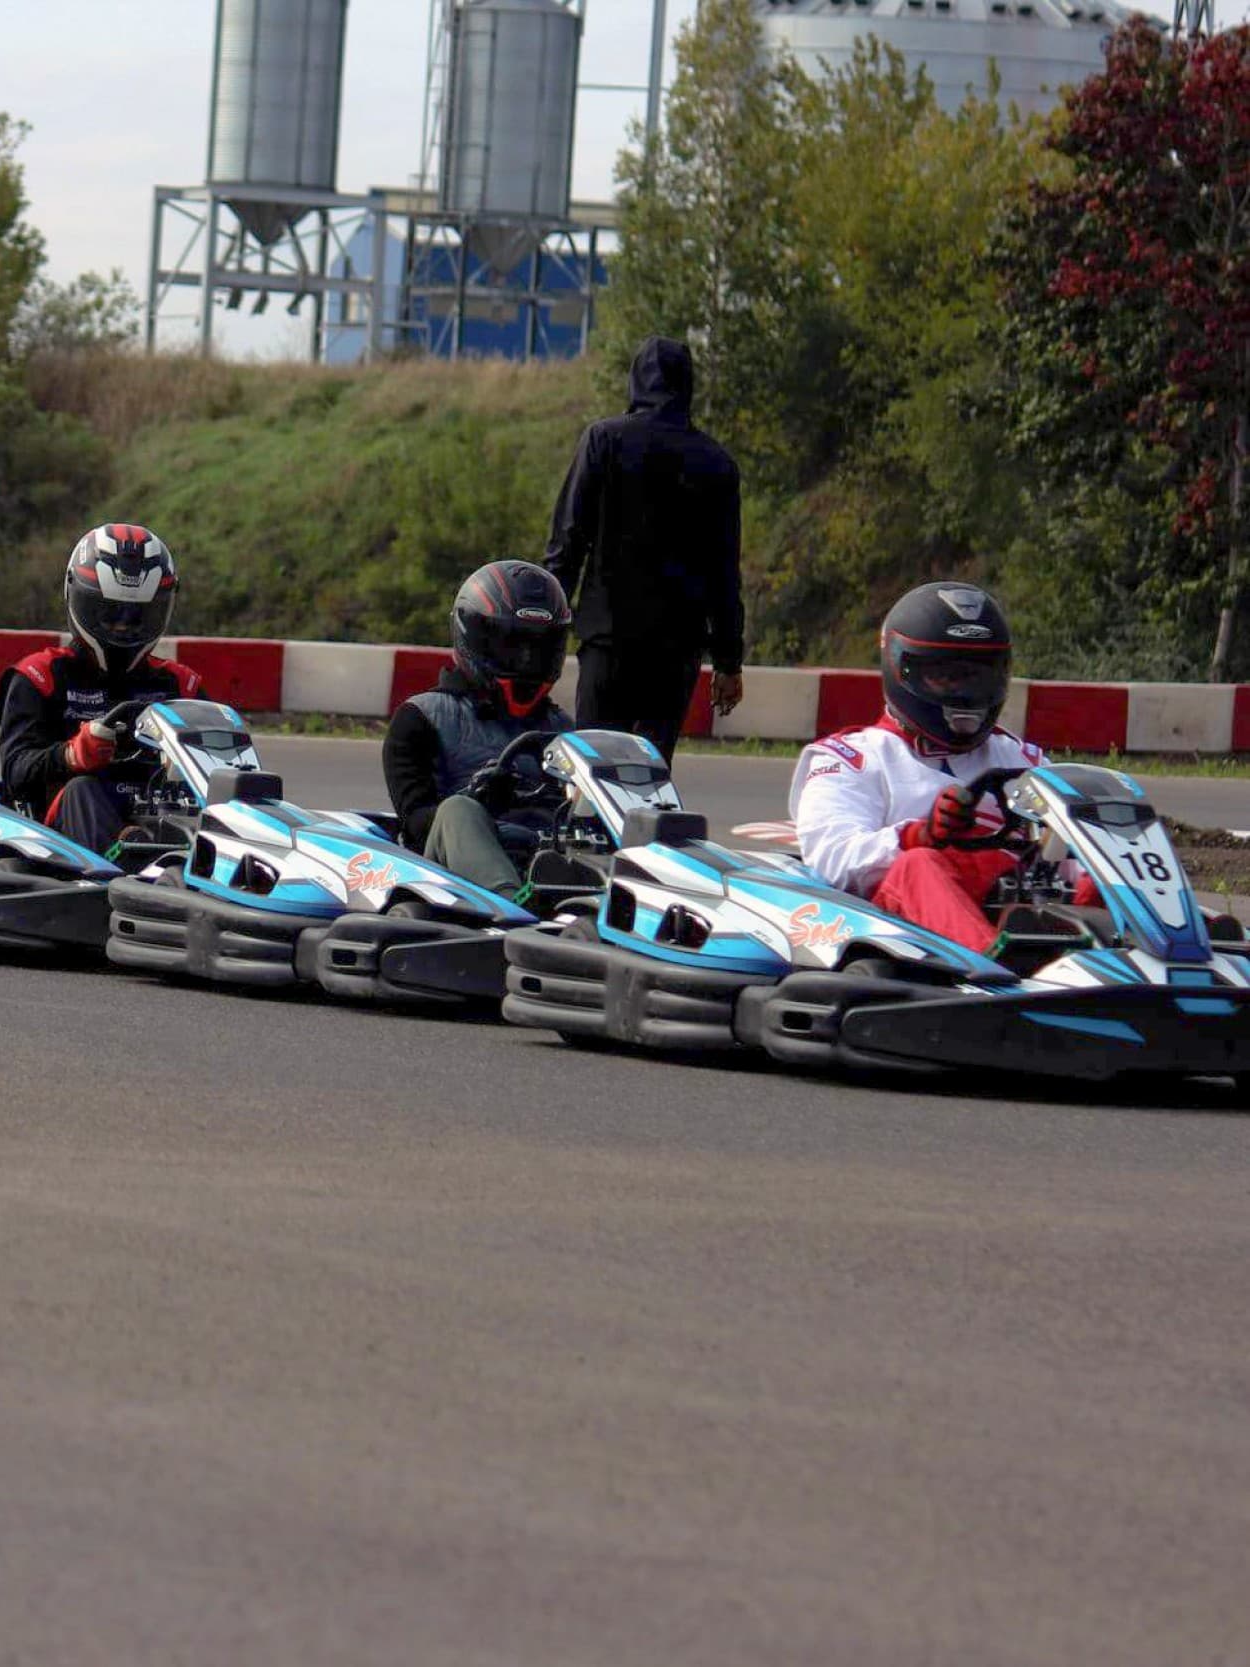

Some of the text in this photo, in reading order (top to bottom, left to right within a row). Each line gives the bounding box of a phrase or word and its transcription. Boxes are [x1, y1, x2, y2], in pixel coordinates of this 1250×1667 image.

[346, 852, 398, 891] Sodi
[1119, 852, 1171, 881] 18
[789, 903, 853, 947] Sodi
